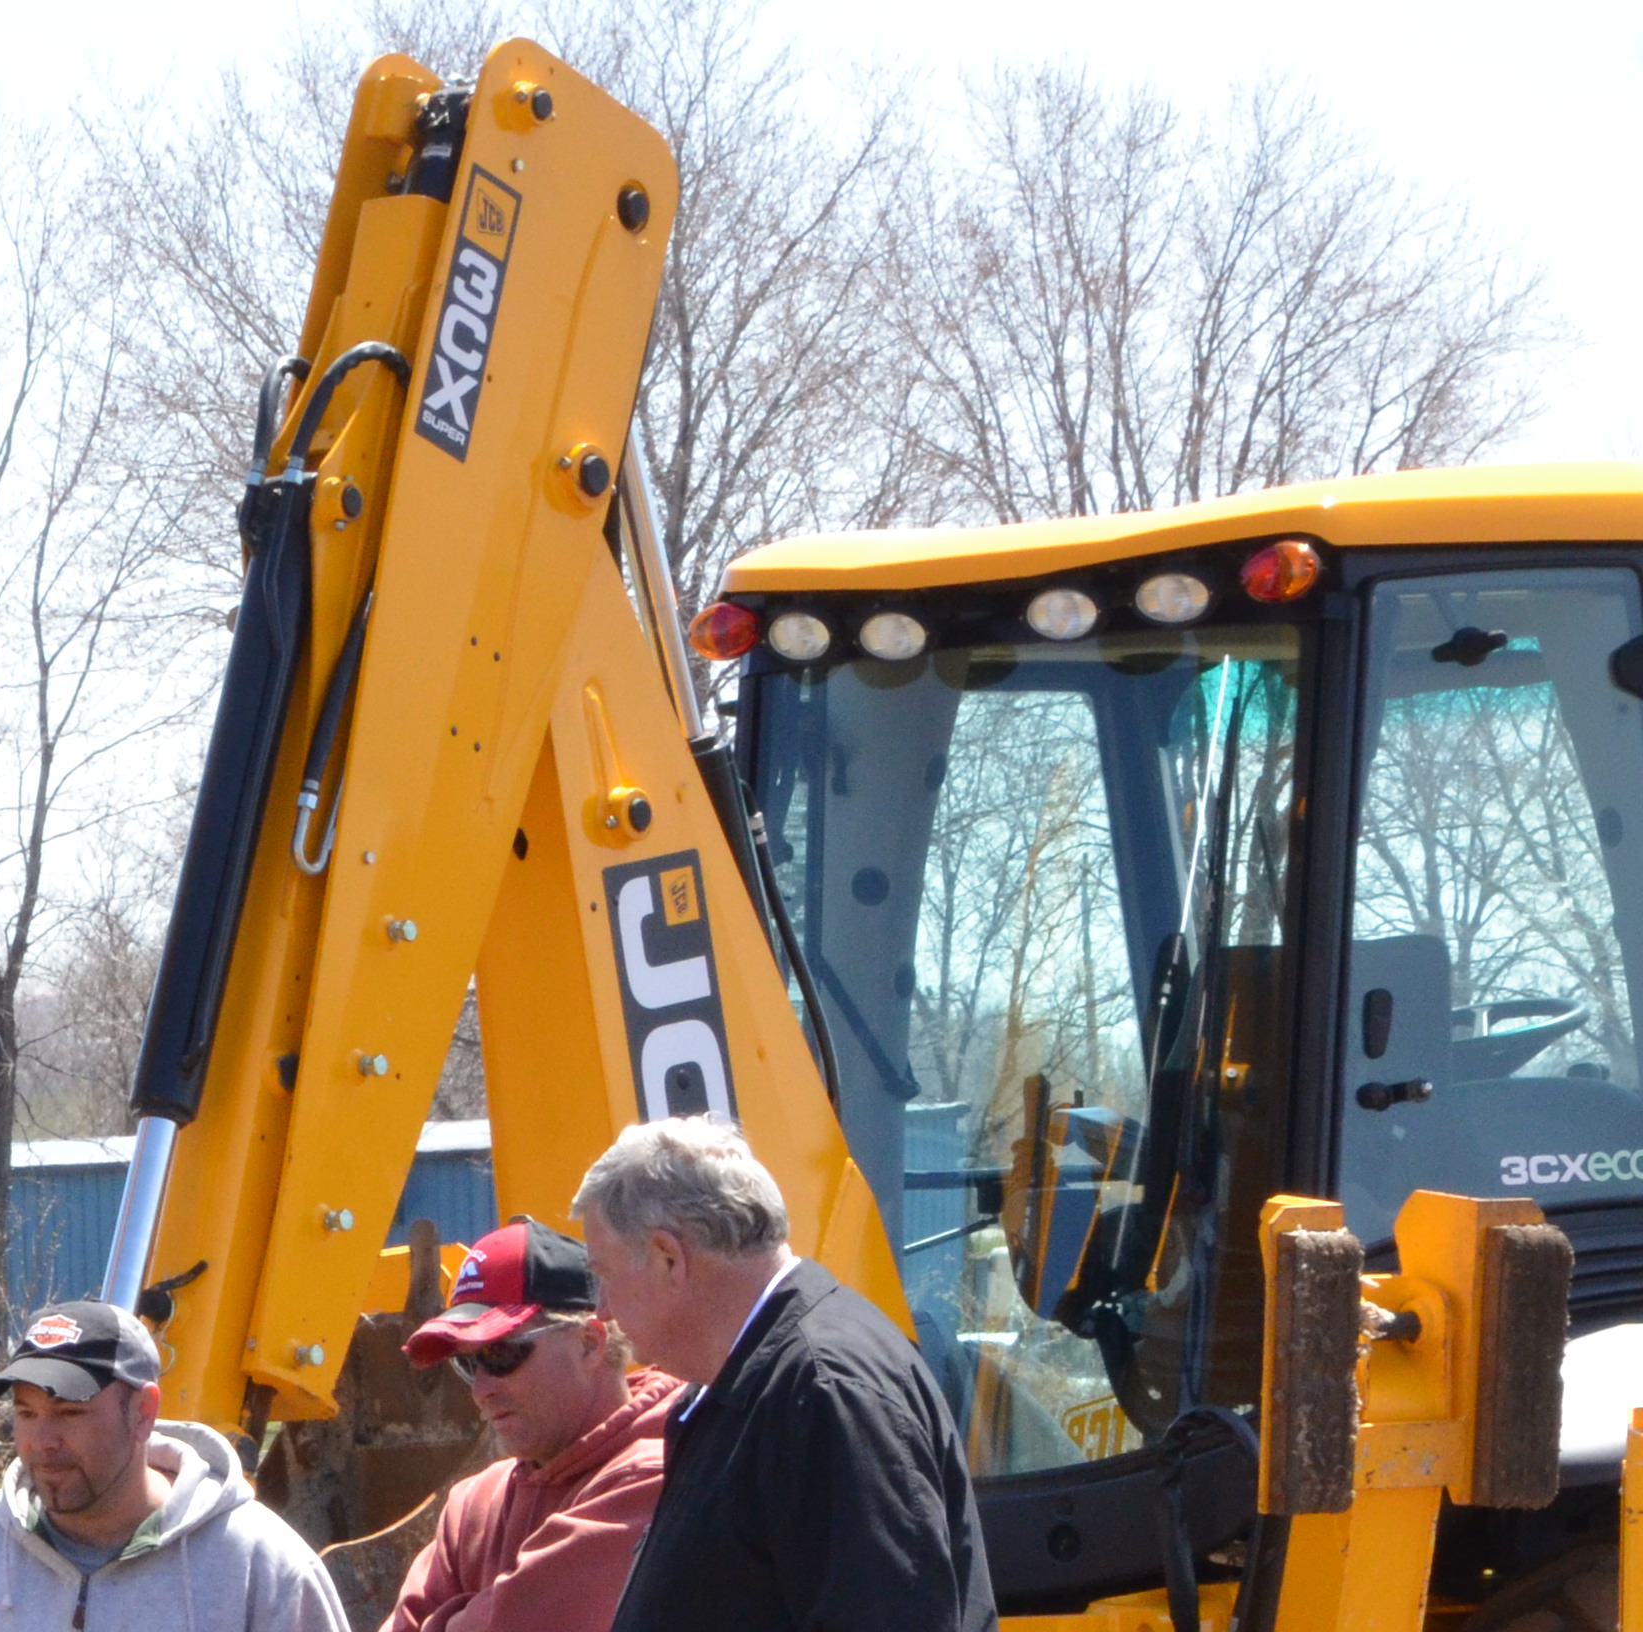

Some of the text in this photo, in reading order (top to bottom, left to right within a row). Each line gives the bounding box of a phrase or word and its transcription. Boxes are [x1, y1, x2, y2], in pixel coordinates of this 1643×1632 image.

[478, 196, 504, 233] JCB
[423, 247, 498, 432] 3CX
[421, 408, 466, 447] SUPER
[617, 874, 734, 1124] JC
